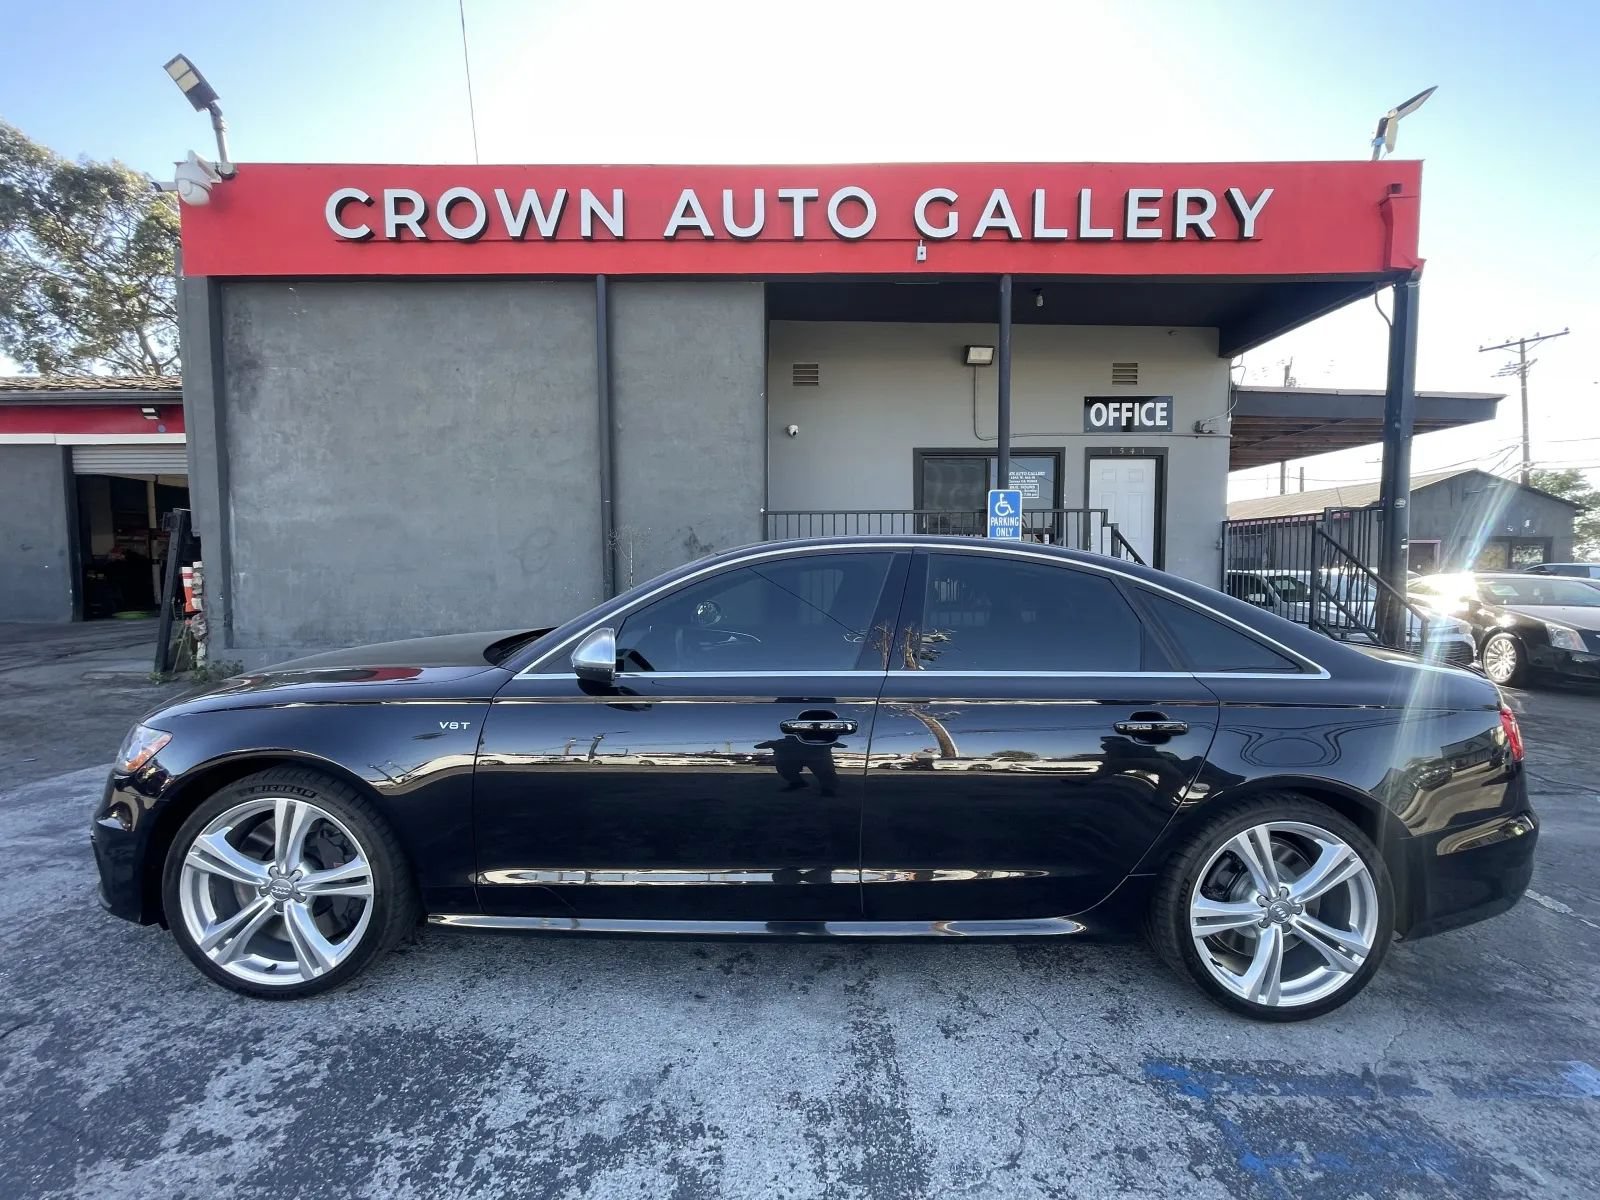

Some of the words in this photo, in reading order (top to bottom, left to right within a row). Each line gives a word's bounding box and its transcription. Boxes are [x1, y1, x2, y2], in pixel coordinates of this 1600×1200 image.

[325, 187, 625, 240] CROWN
[663, 186, 877, 240] AUTO
[914, 187, 1275, 239] GALLERY
[1089, 402, 1168, 427] OFFICE
[990, 516, 1019, 527] PARKING
[995, 527, 1014, 537] ONLY
[439, 721, 471, 730] V8T
